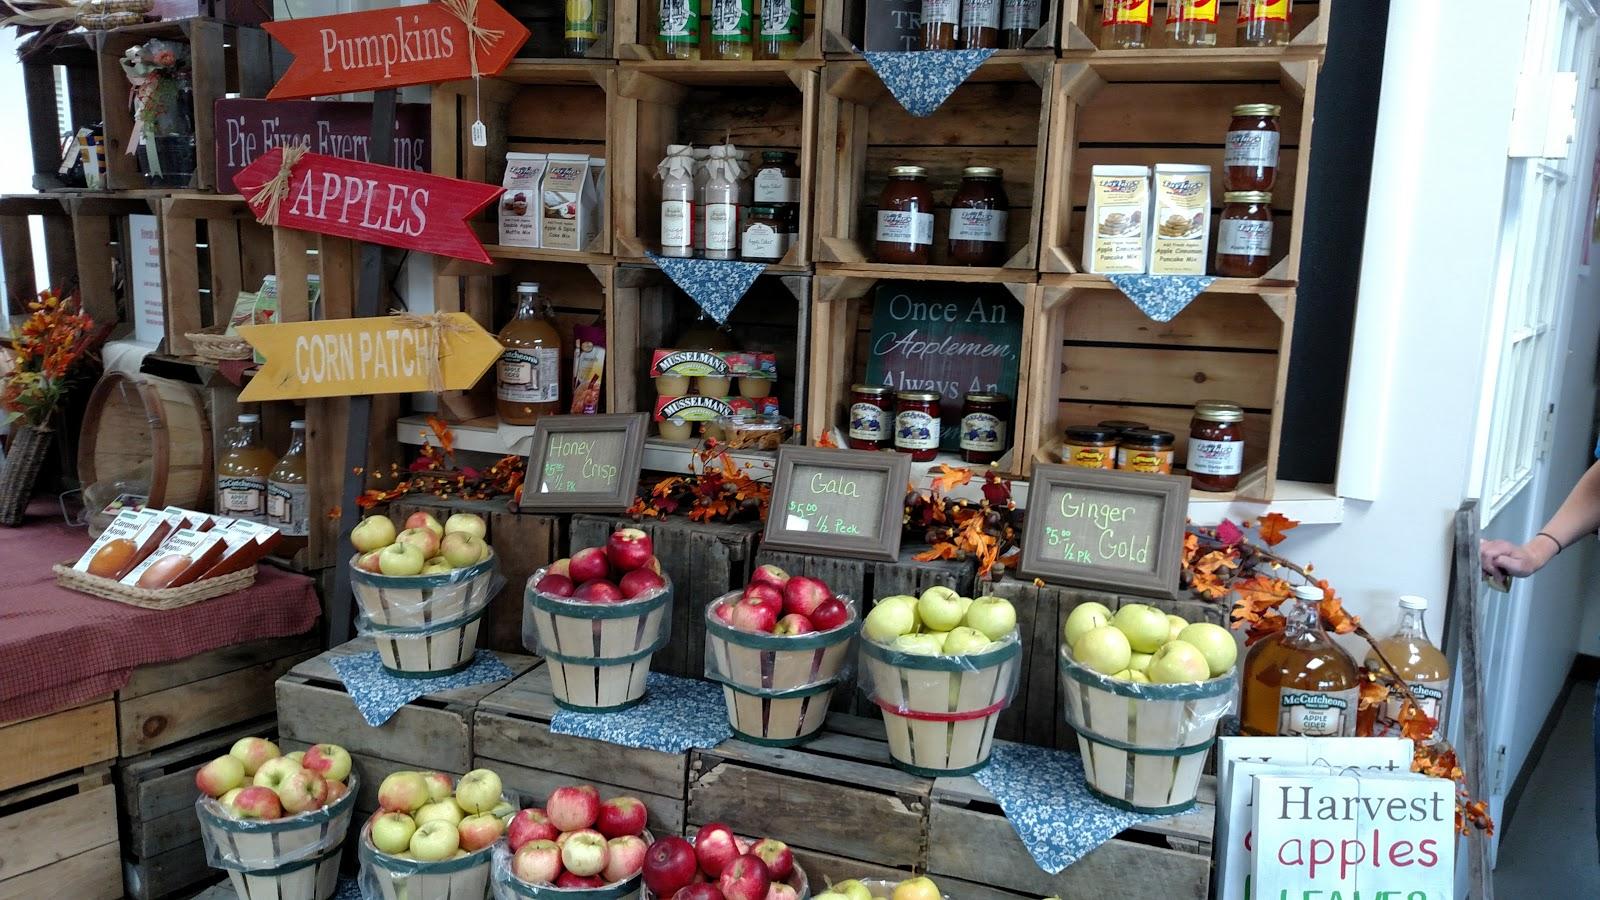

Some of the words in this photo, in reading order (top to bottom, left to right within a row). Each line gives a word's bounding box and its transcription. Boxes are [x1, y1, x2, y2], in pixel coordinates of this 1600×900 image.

[320, 15, 454, 78] Pumpkins
[226, 116, 257, 167] Pie
[289, 169, 430, 237] APPLES
[890, 294, 958, 322] Once
[965, 297, 1007, 323] An
[296, 334, 355, 384] CORN
[360, 328, 430, 379] PATCH
[874, 329, 1016, 361] Applemen,
[659, 351, 728, 374] MUSSELMAN'S
[664, 397, 730, 419] MUSSELMAN'S
[549, 435, 596, 461] Honey
[582, 458, 617, 486] Crisp
[810, 472, 861, 498] Gala
[113, 519, 142, 531] Caramel
[1060, 492, 1136, 530] Ginger
[169, 535, 200, 548] Caramel
[834, 518, 860, 535] Peck
[1098, 529, 1150, 564] Gold
[1277, 786, 1445, 822] Harvest
[1278, 829, 1439, 880] apples
